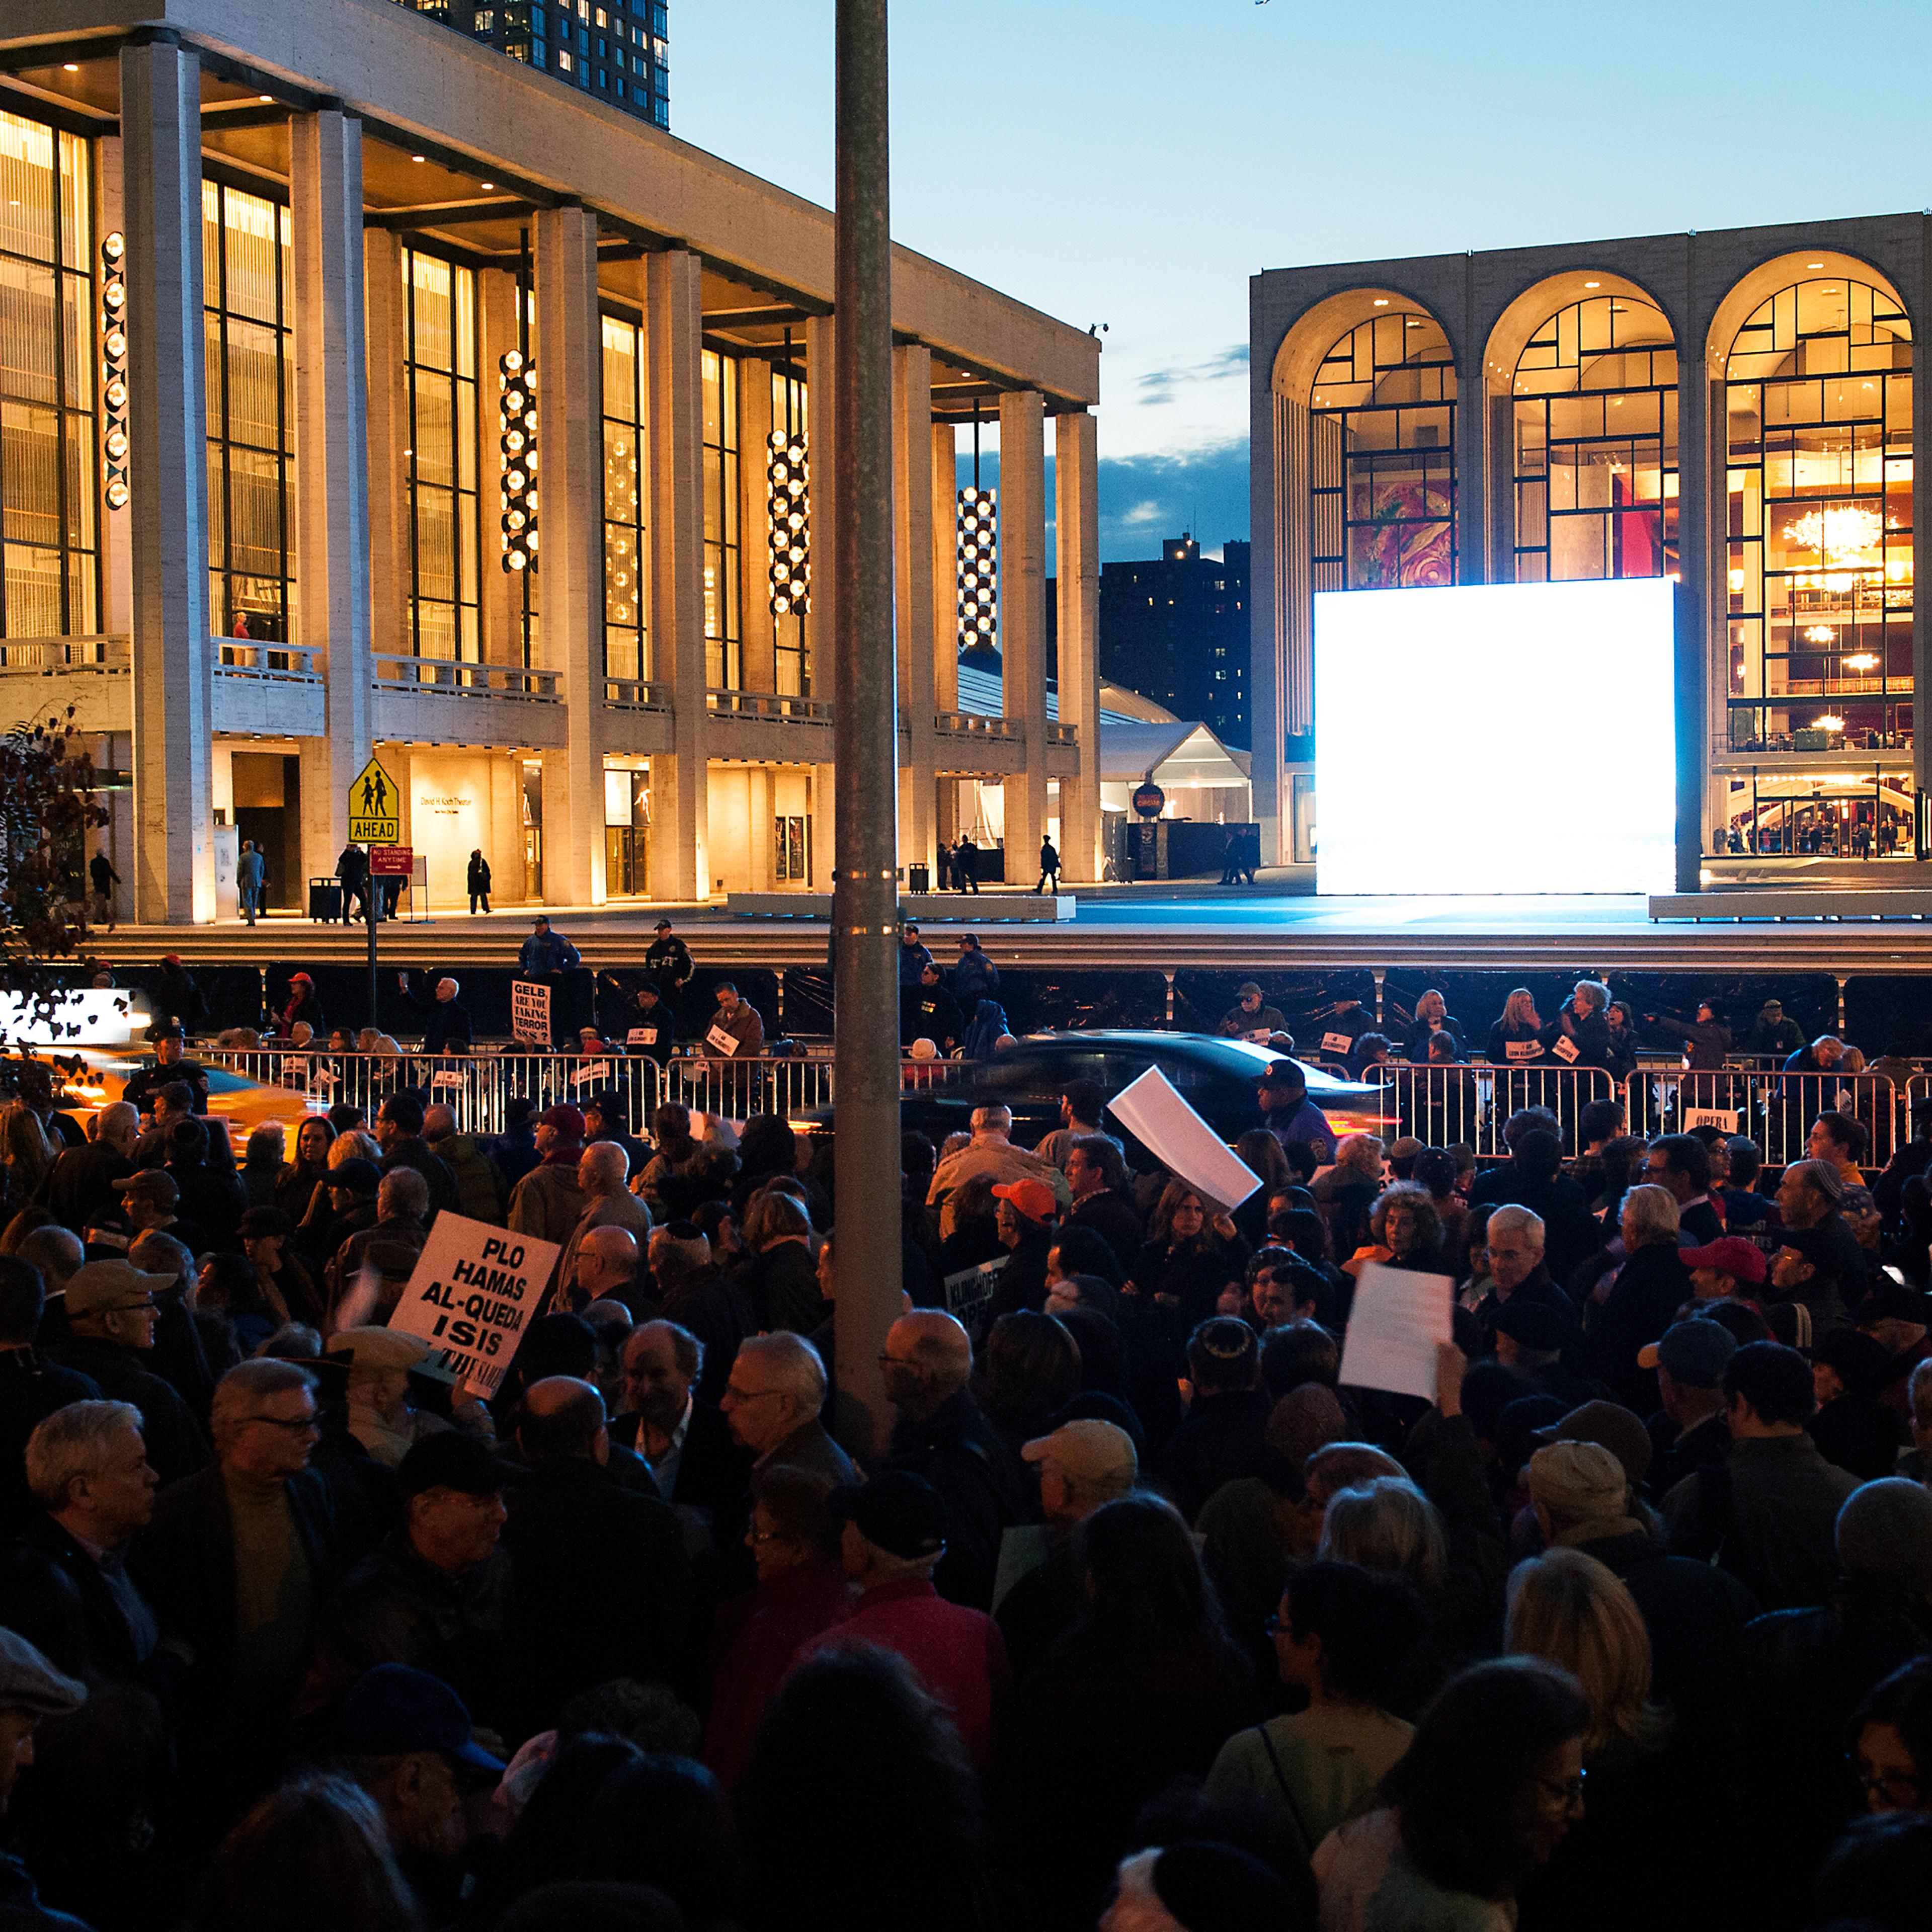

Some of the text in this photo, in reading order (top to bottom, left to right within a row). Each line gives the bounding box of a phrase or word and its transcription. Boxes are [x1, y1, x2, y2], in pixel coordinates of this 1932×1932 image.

[421, 797, 434, 805] David
[442, 797, 453, 805] Koch
[354, 822, 394, 837] AHEAD
[515, 985, 547, 999] GELB,
[516, 996, 545, 1009] ARE YOU
[515, 1007, 547, 1020] TAKING
[515, 1017, 547, 1030] TERROR
[1696, 1115, 1728, 1129] OPERA
[481, 1238, 525, 1269] PLO
[452, 1259, 527, 1301] HAMAS
[421, 1281, 525, 1332] AL-QUEDA
[432, 1315, 503, 1356] ISIS
